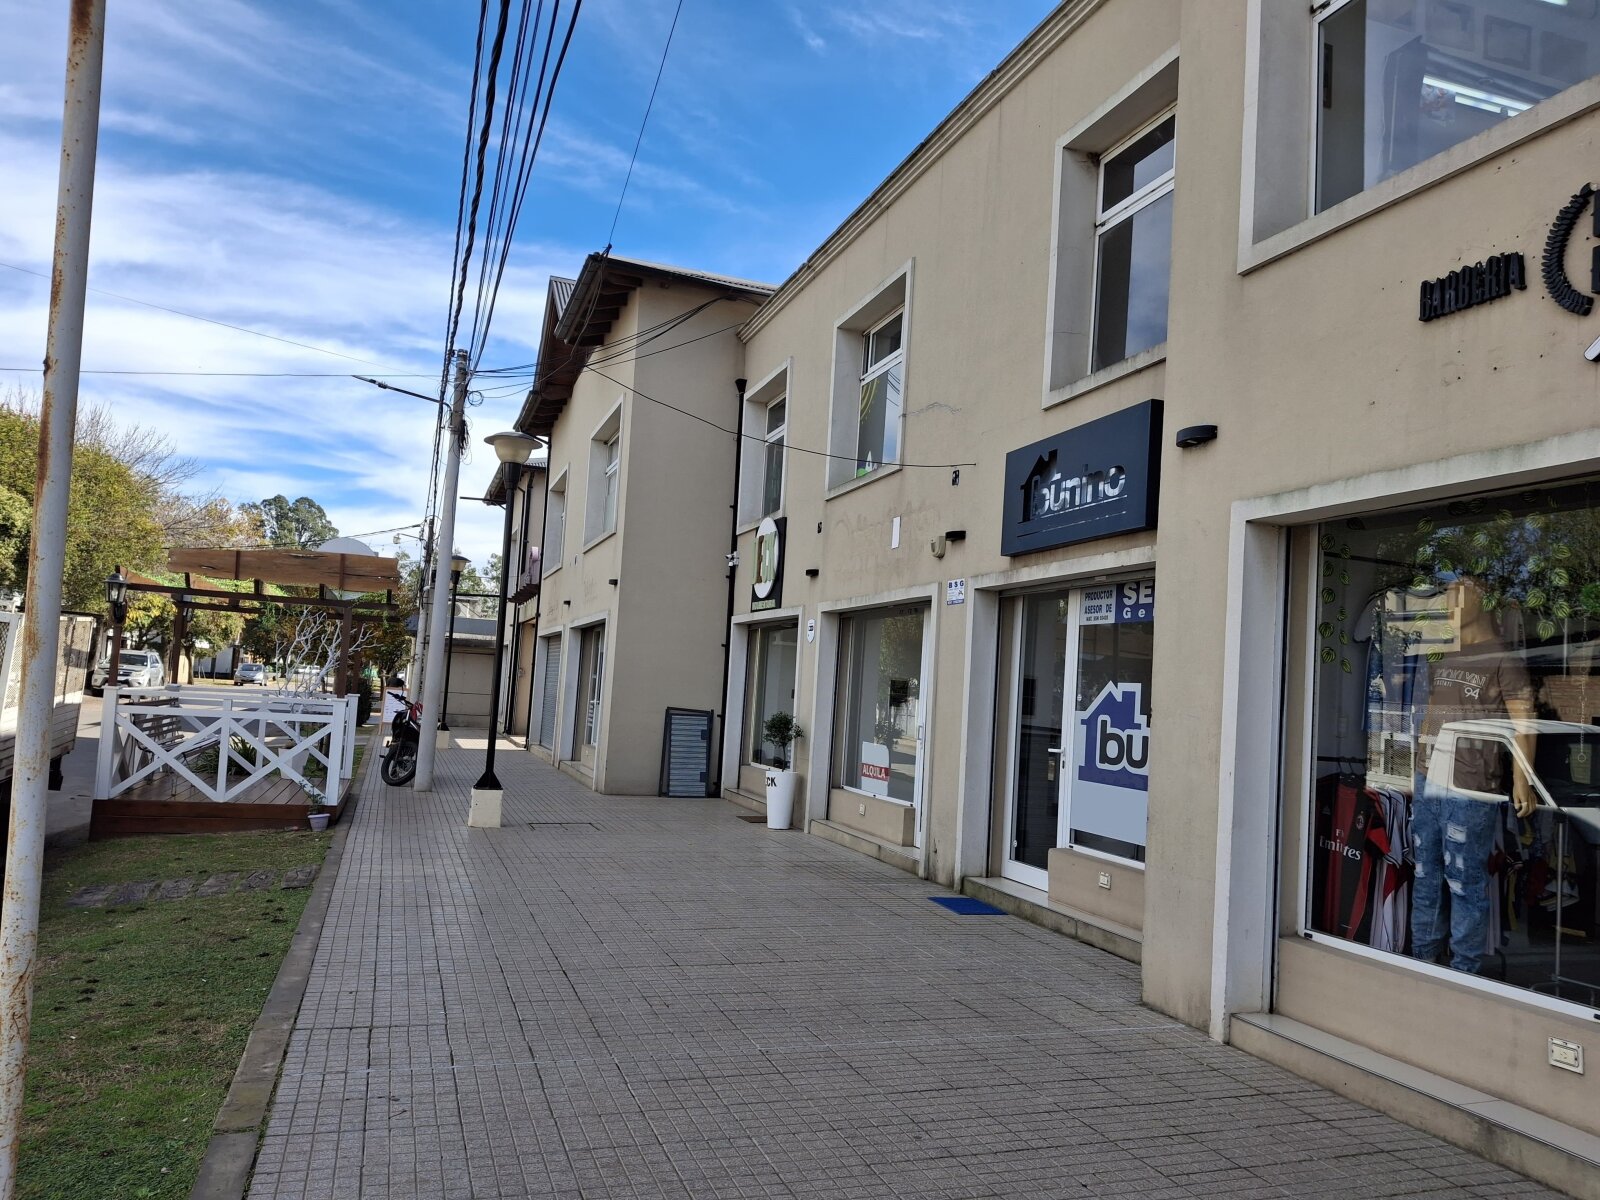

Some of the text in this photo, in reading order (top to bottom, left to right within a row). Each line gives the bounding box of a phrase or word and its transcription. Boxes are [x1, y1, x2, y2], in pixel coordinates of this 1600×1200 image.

[1085, 590, 1113, 601] PRODUCTOR
[1085, 603, 1113, 614] ASESOR DE
[1099, 719, 1149, 769] bu
[862, 764, 887, 779] ALQUILA
